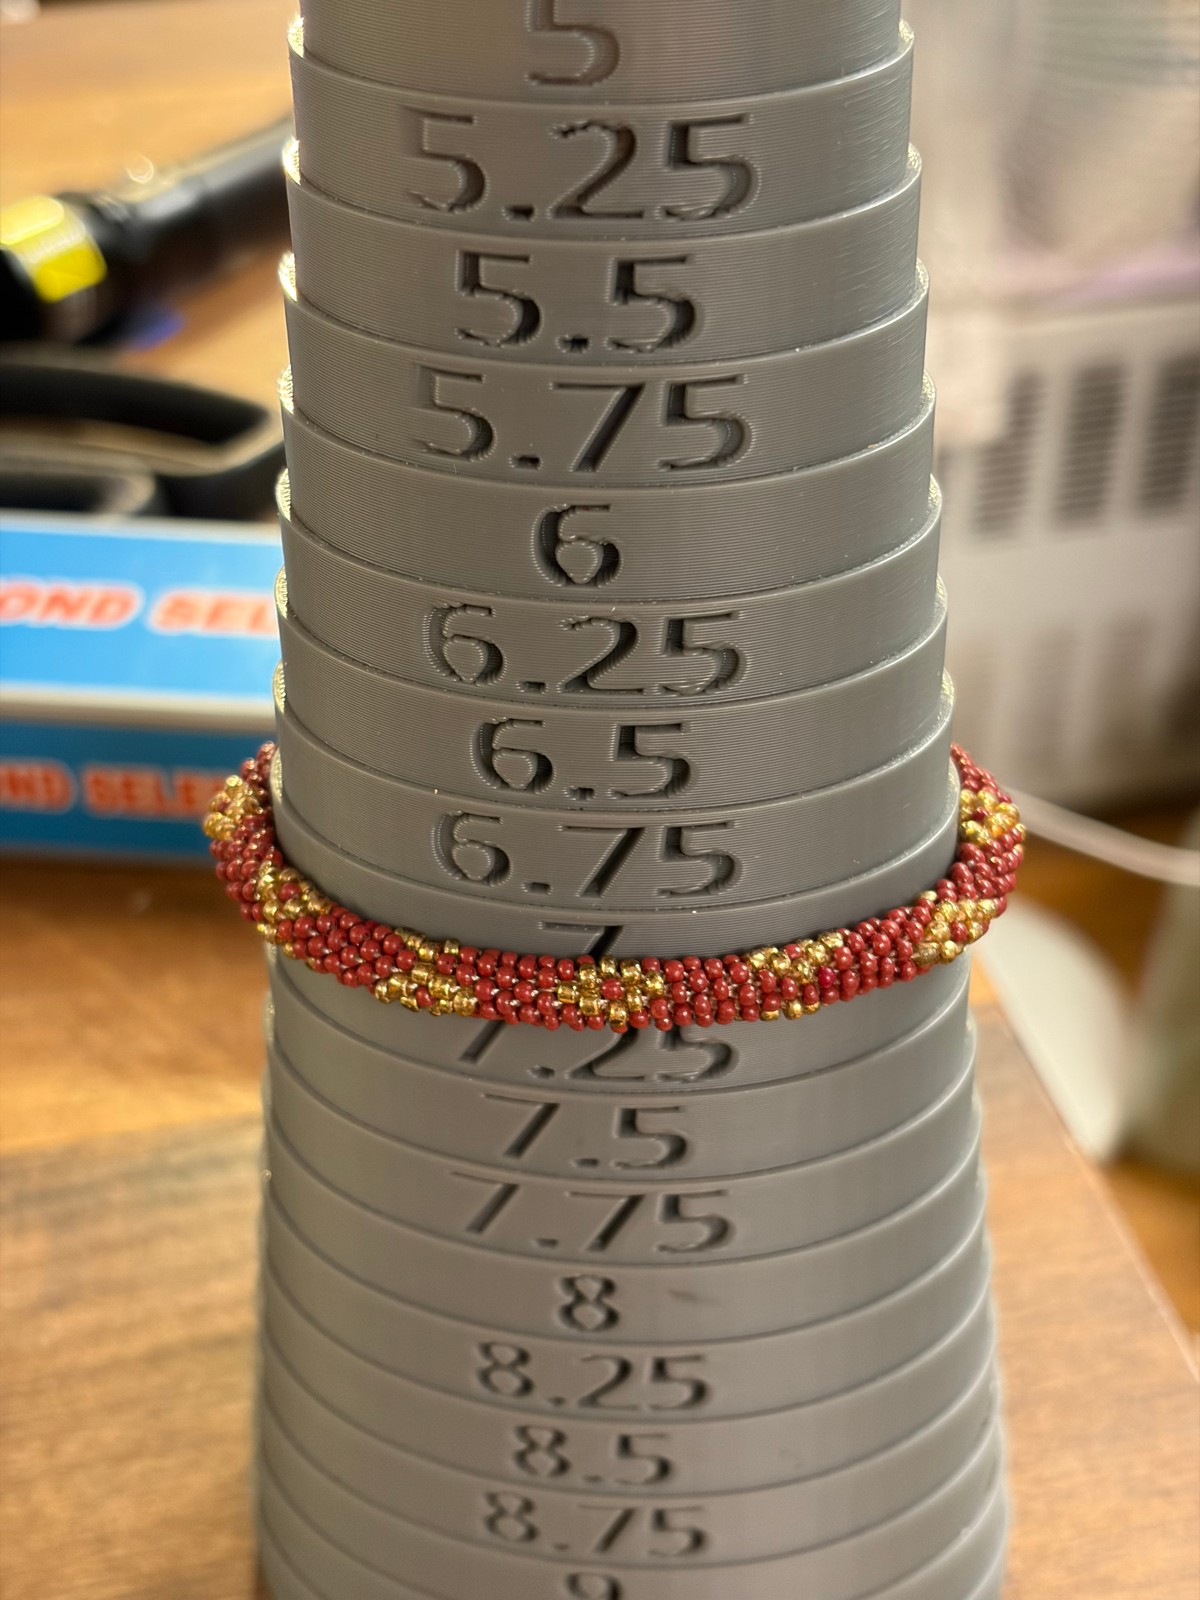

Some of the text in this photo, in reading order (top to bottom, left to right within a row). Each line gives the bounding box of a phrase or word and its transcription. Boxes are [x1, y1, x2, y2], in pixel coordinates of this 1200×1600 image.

[525, 0, 621, 86] 5
[407, 110, 762, 221] 5.25
[454, 249, 701, 354] 5.5
[412, 364, 757, 473] 5.75
[530, 502, 623, 588] 6
[422, 603, 748, 697] 6.25
[469, 717, 693, 801] 6.5
[431, 811, 743, 898] 6.75
[483, 1093, 689, 1169] 7.5
[449, 1171, 736, 1254] 7.75
[556, 1273, 622, 1333] 8
[475, 1340, 713, 1411] 8.25
[512, 1424, 675, 1487] 8.5
[483, 1490, 709, 1557] 8.75
